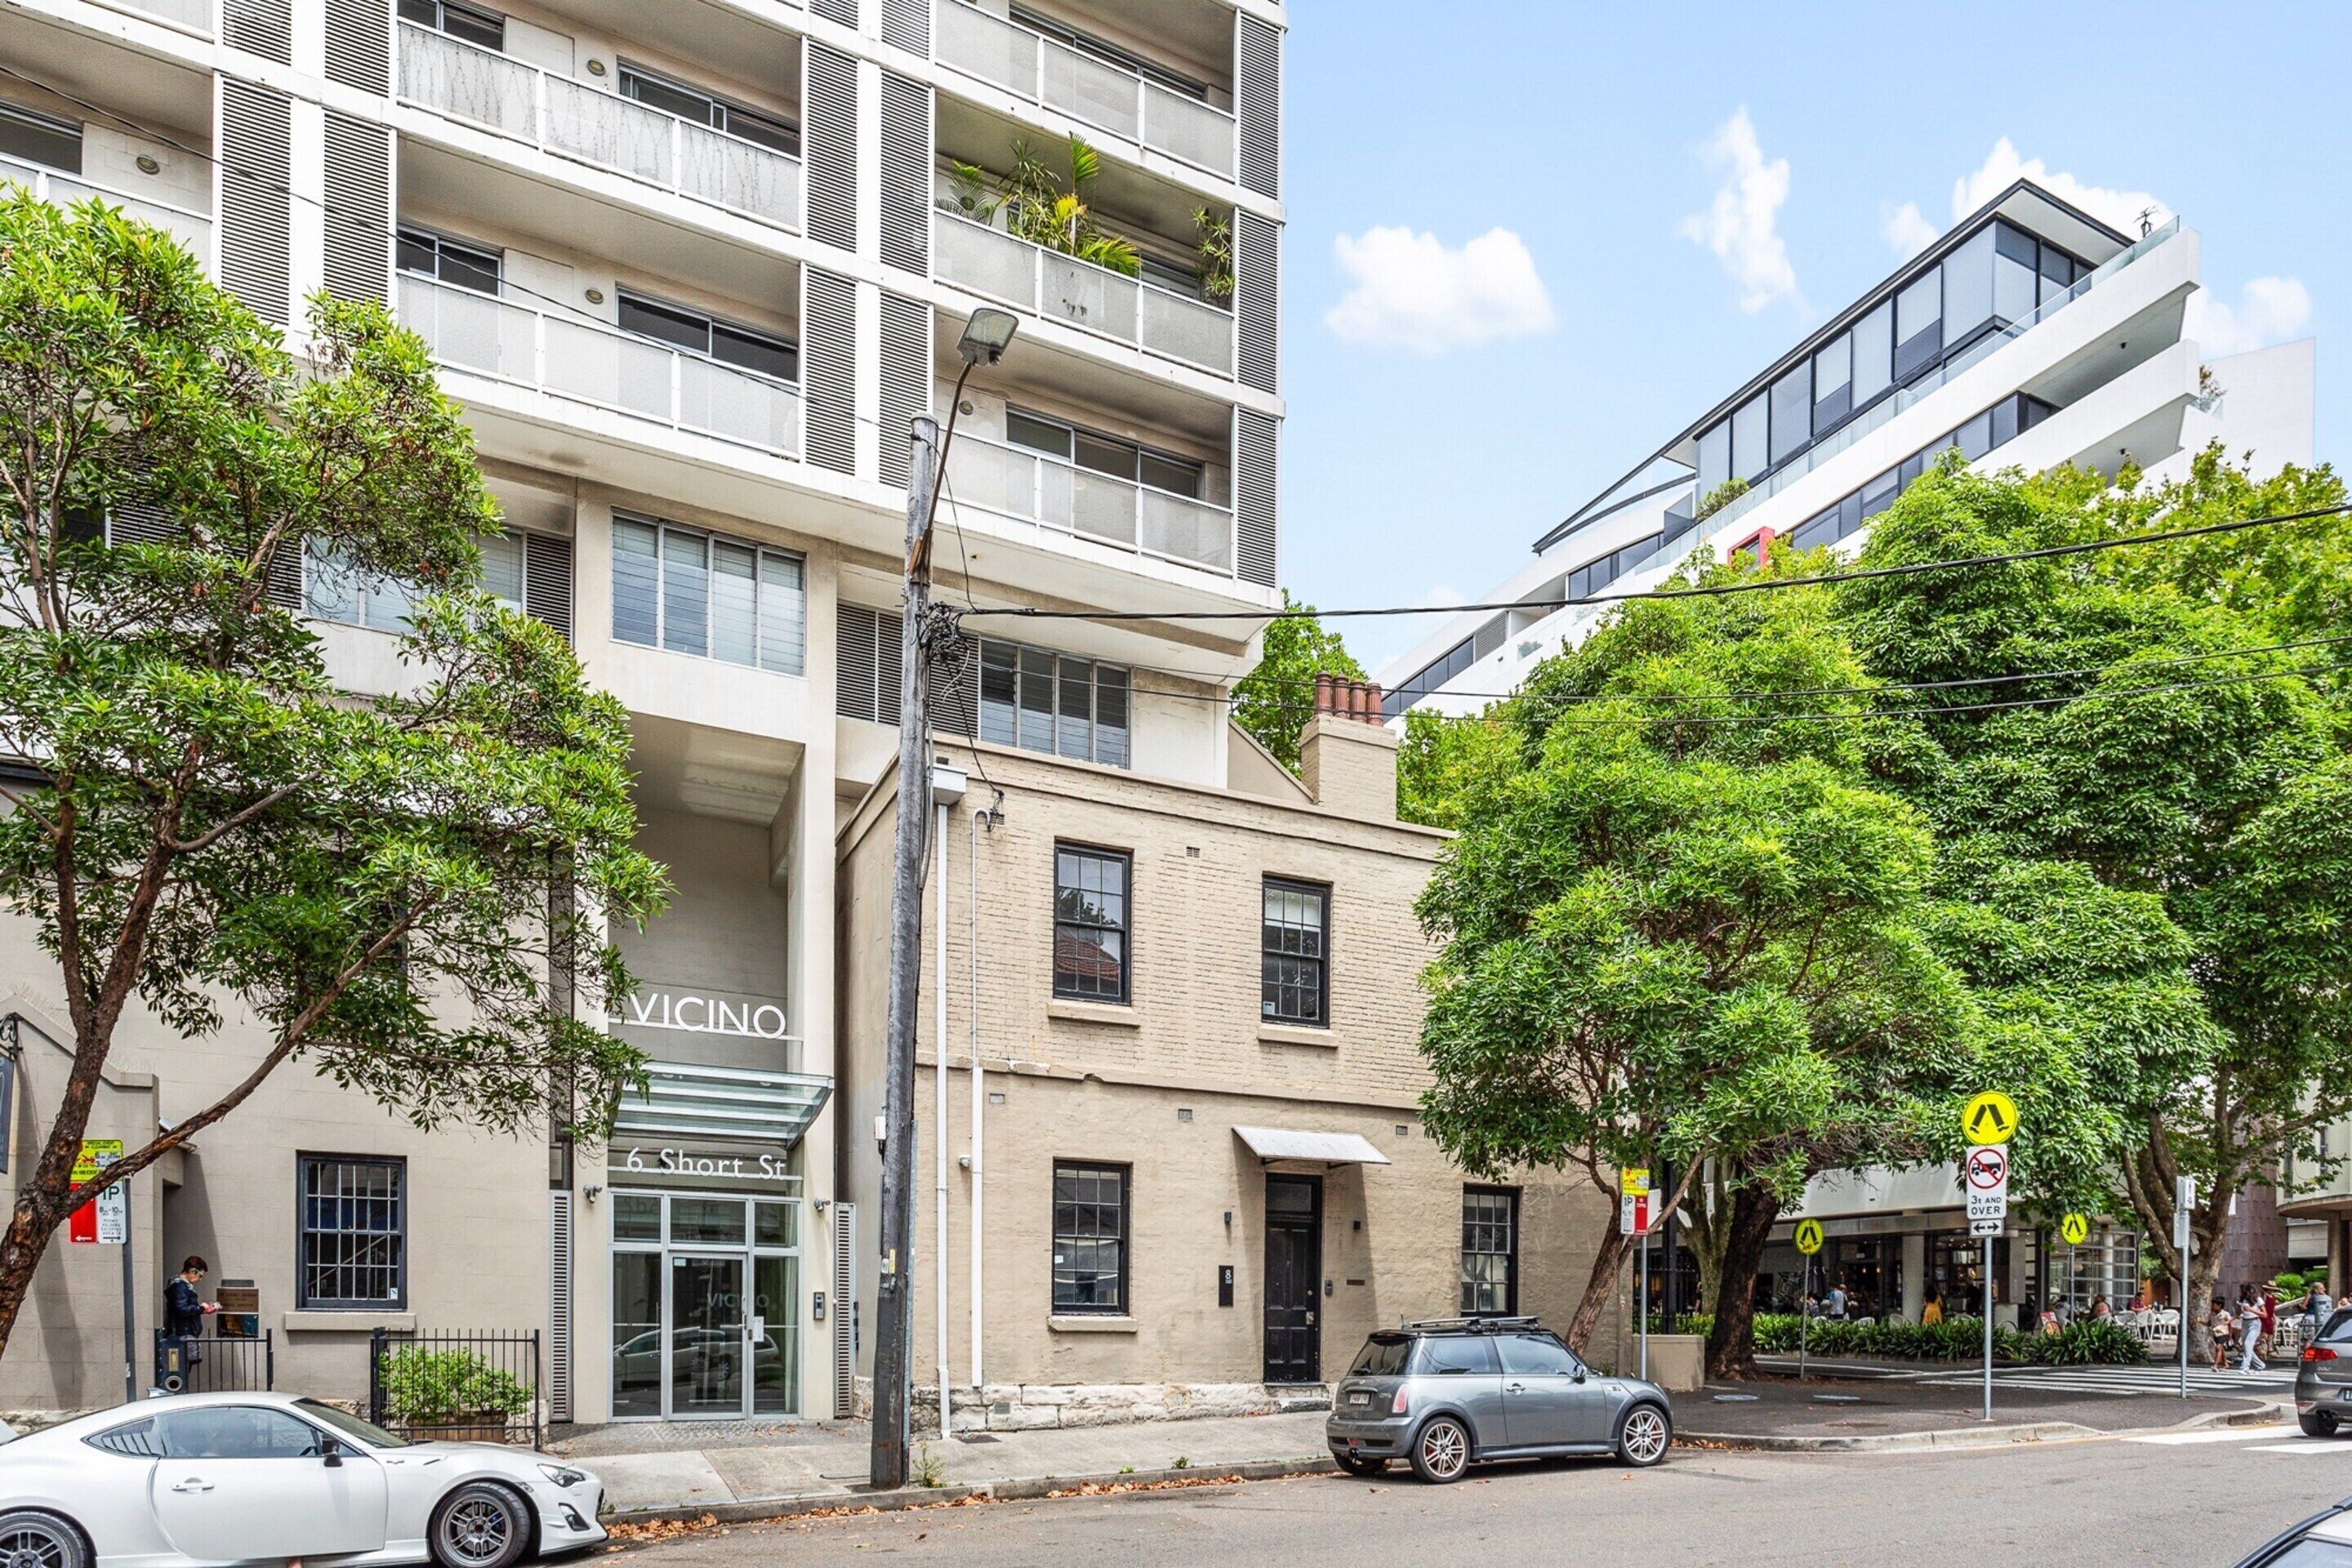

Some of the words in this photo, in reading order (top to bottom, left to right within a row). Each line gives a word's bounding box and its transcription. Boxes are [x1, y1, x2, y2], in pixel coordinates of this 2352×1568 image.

[629, 992, 786, 1040] VICINO
[626, 1147, 643, 1173] 6
[660, 1147, 743, 1178] Short
[759, 1154, 786, 1181] St
[1624, 1196, 1633, 1207] 1P
[1971, 1195, 1981, 1205] 3t
[1971, 1205, 2001, 1215] OVER
[1225, 1269, 1232, 1280] 8
